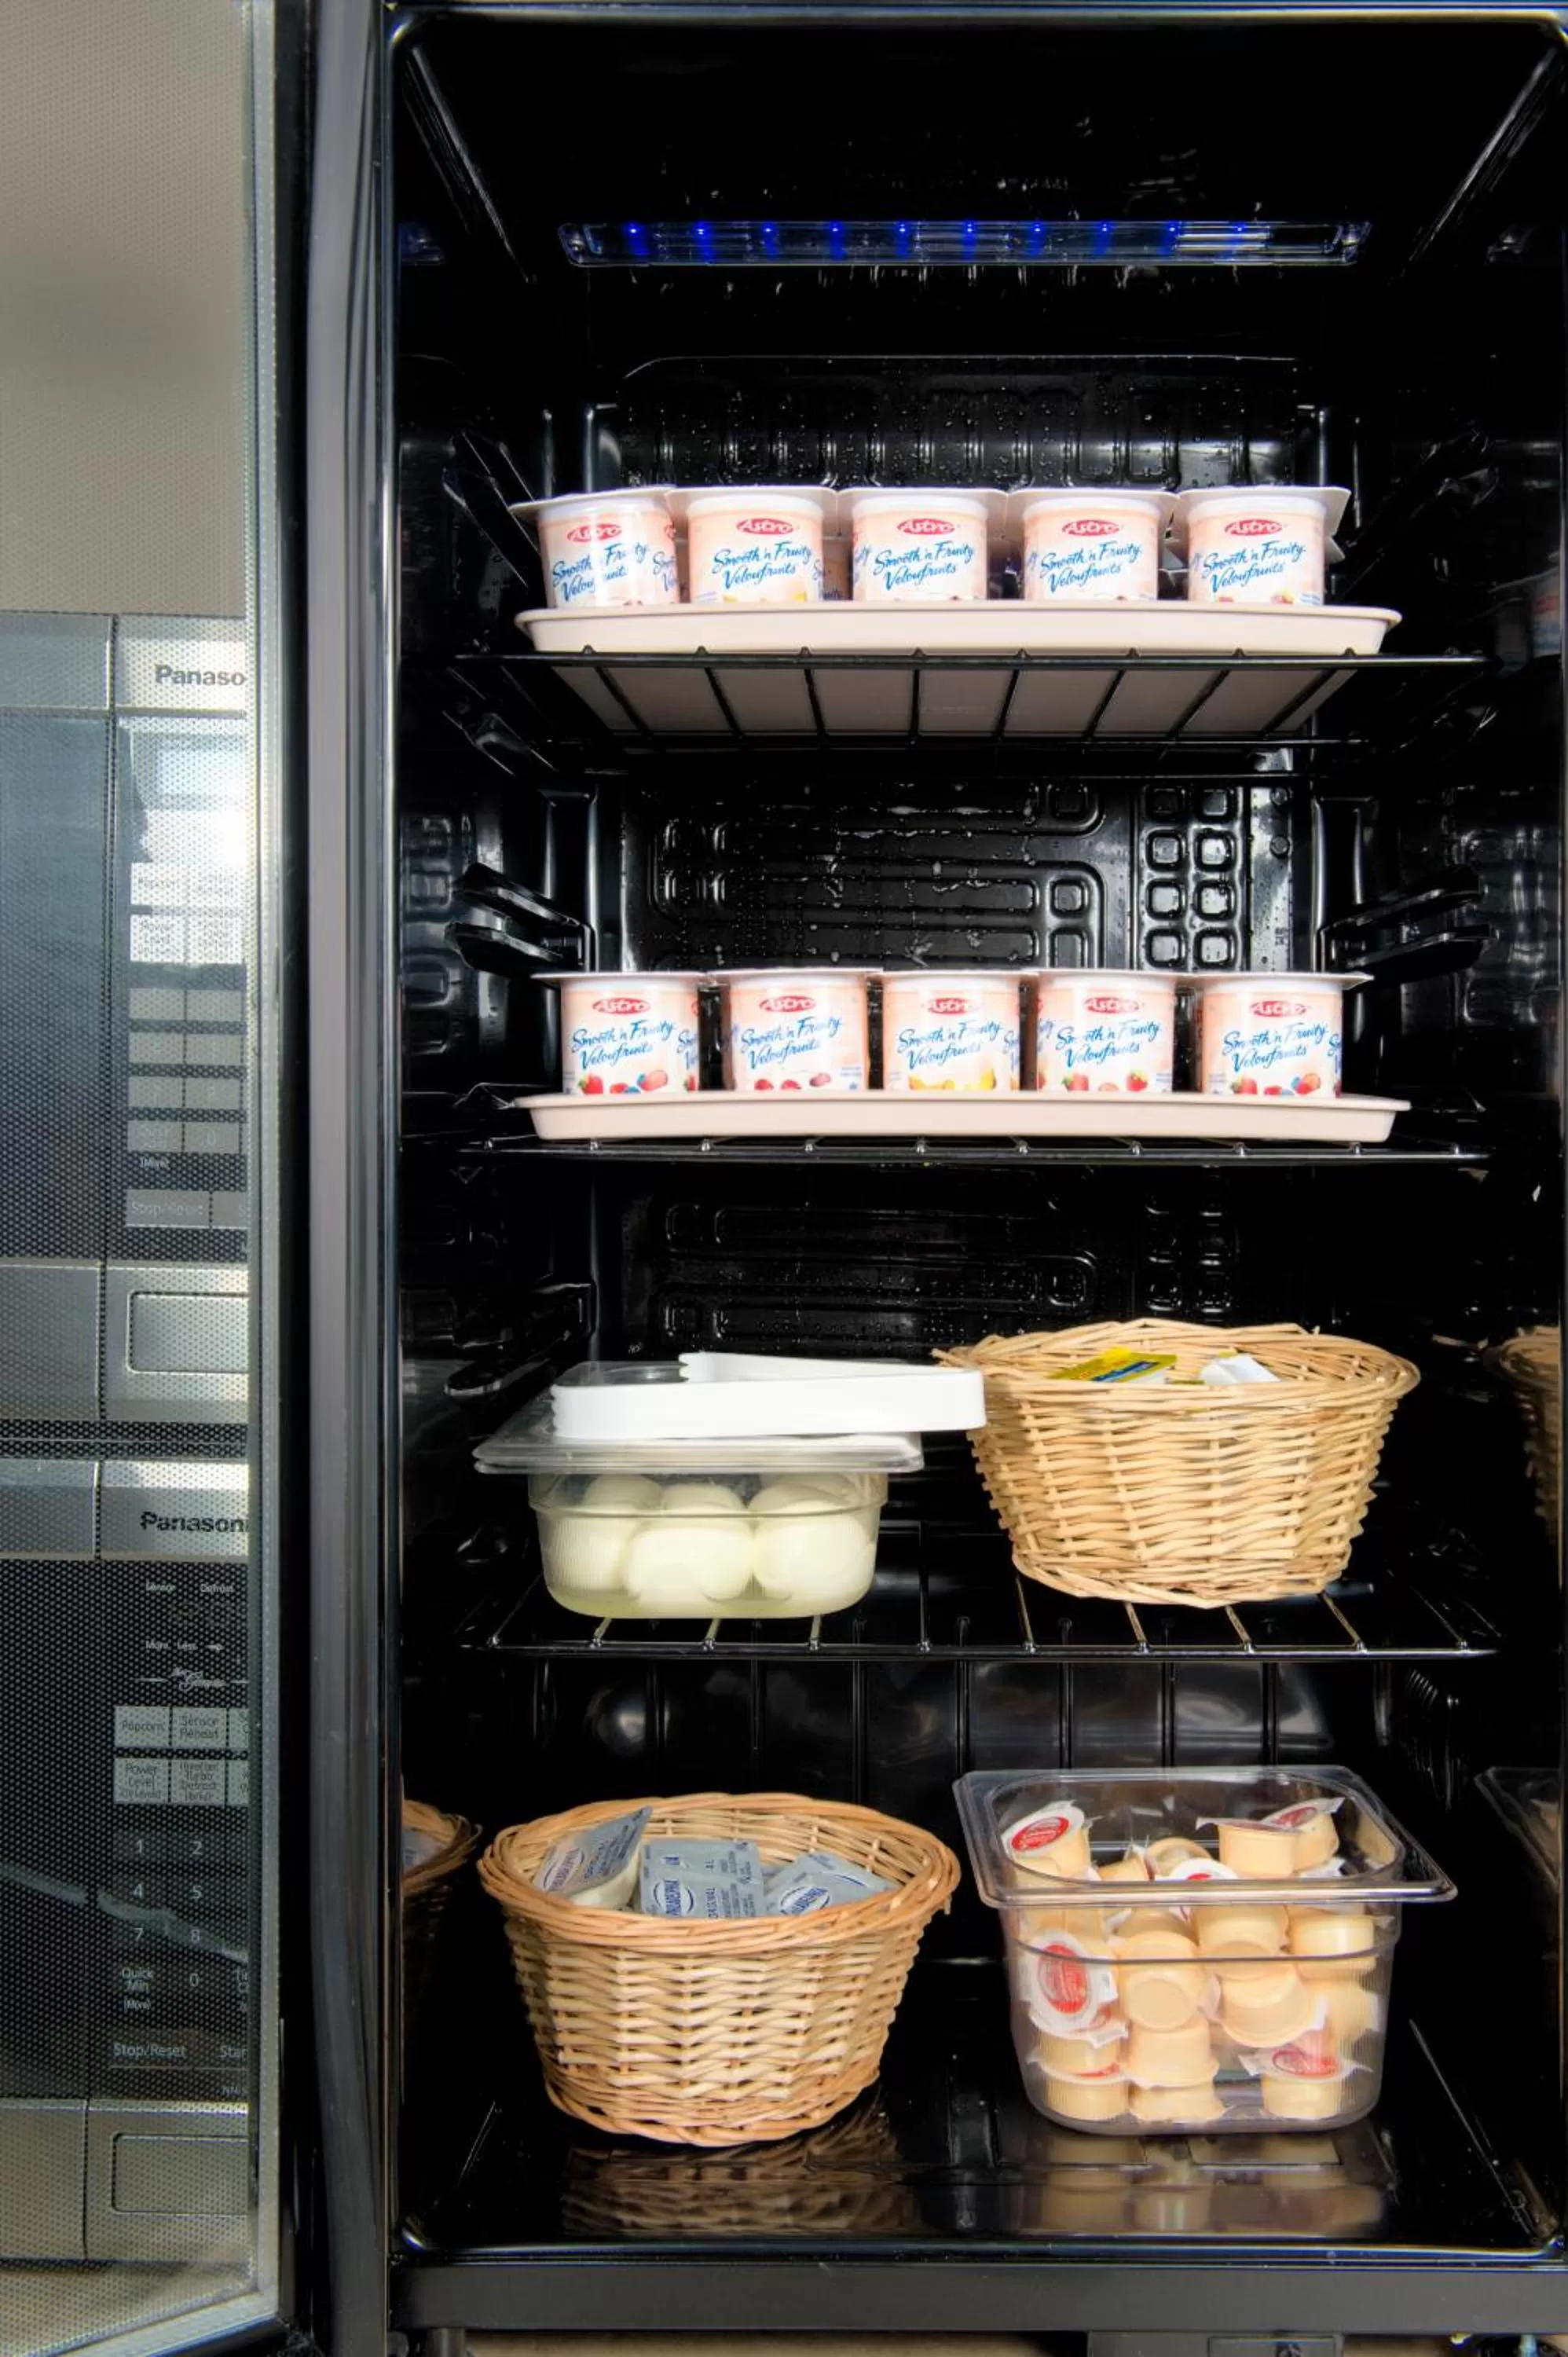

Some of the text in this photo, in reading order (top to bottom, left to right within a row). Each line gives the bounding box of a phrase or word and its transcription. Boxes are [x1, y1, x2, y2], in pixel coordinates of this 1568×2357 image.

[736, 519, 794, 534] Astro
[897, 519, 955, 534] Astro
[1062, 519, 1119, 536] Astro
[1225, 519, 1283, 535] Astro
[712, 546, 760, 574] Smooth
[775, 541, 811, 564] Fruity
[873, 547, 921, 575] Smooth
[934, 541, 974, 564] Fruity
[1040, 548, 1085, 578] Smooth
[1099, 541, 1141, 563] Fruity
[1202, 548, 1247, 578] Smooth
[1261, 541, 1306, 563] Fruity
[571, 1028, 616, 1054] Smooth
[741, 1025, 783, 1054] Smooth
[897, 1027, 943, 1054] Smooth
